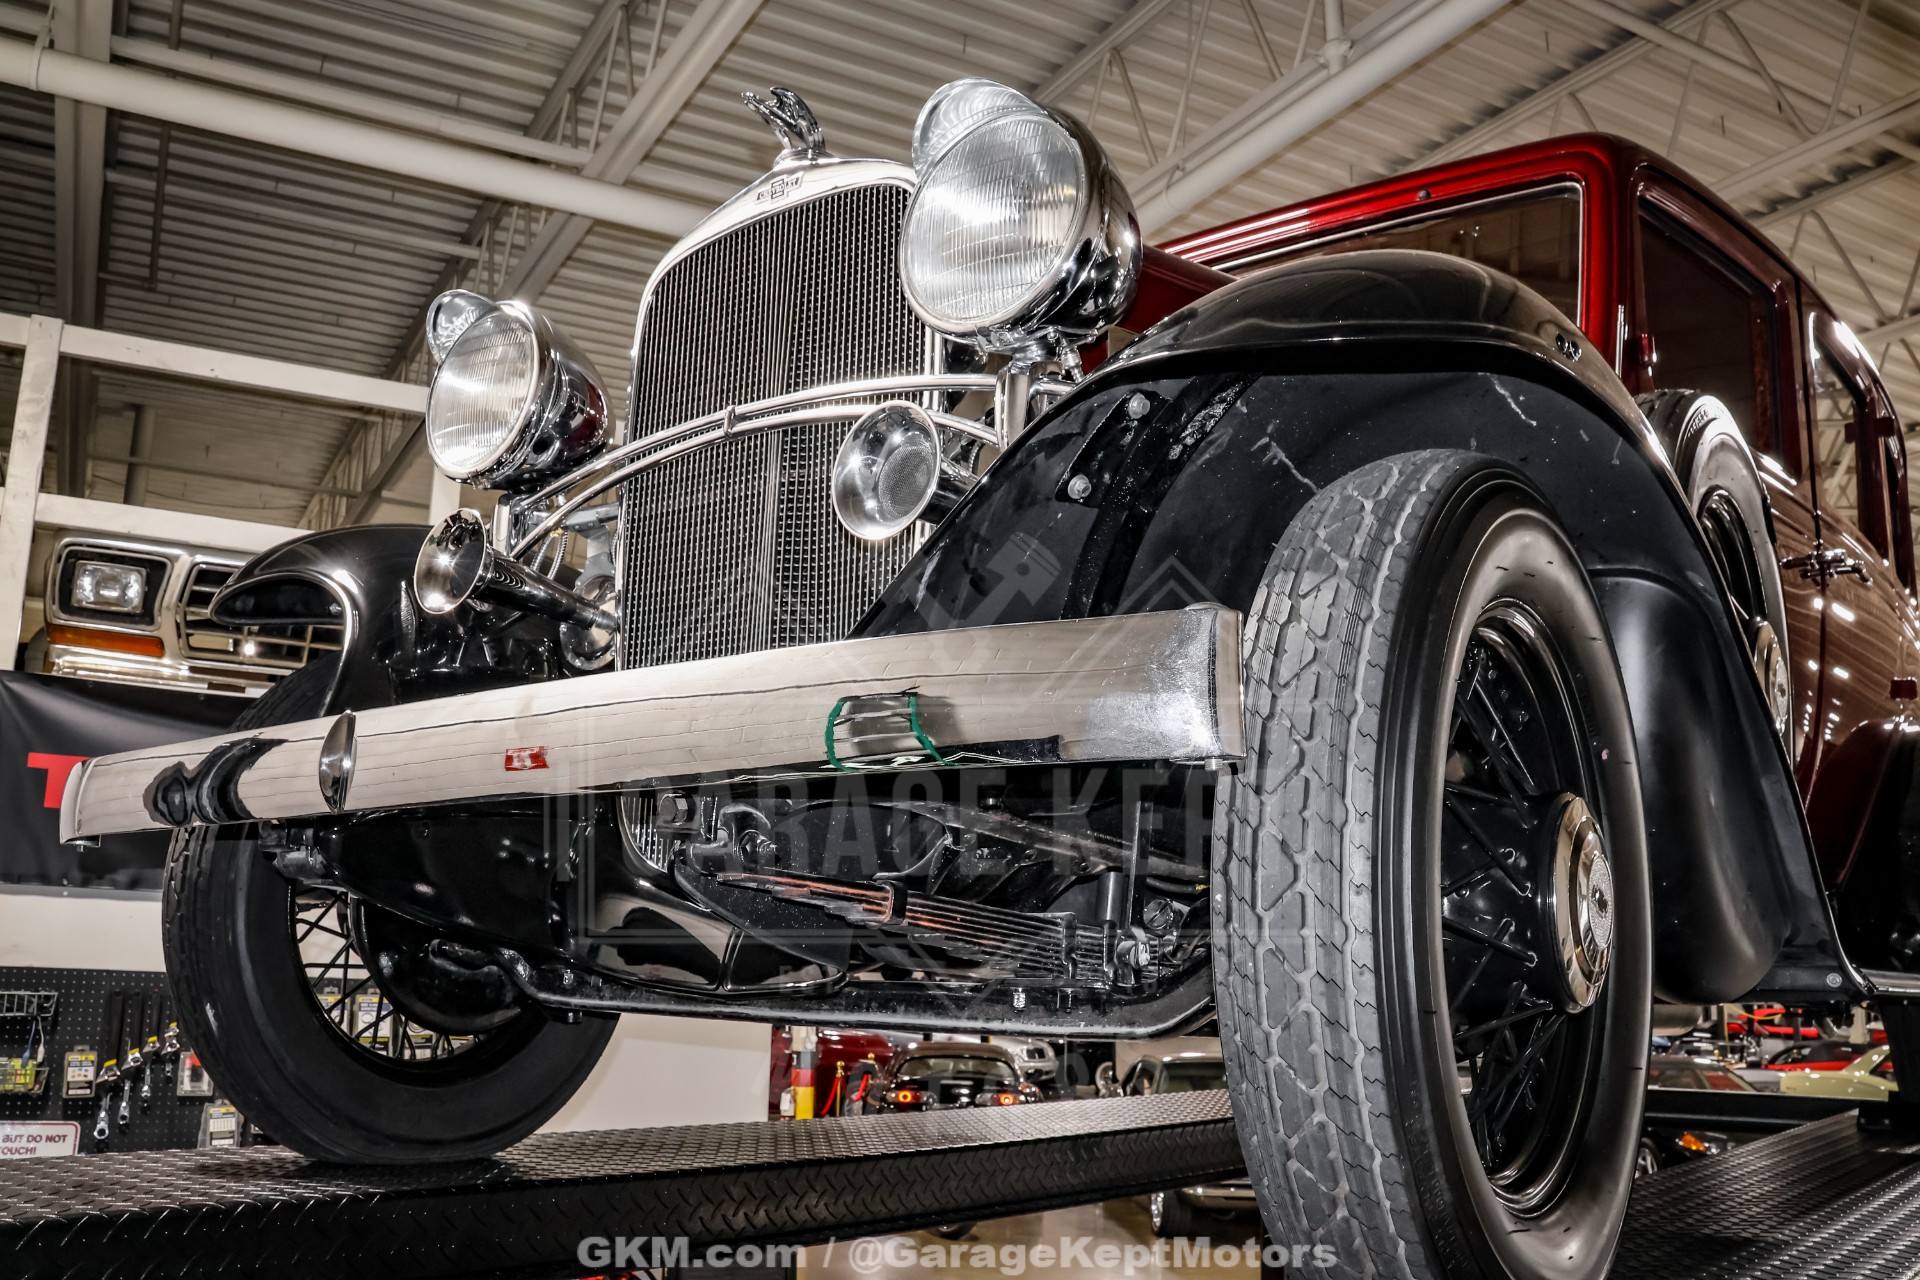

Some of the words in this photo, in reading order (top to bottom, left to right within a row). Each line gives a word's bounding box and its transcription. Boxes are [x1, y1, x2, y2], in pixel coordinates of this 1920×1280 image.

[2, 1134, 25, 1144] BUT
[27, 1134, 43, 1144] DO
[45, 1134, 69, 1144] NOT
[0, 1146, 37, 1156] OUCH!
